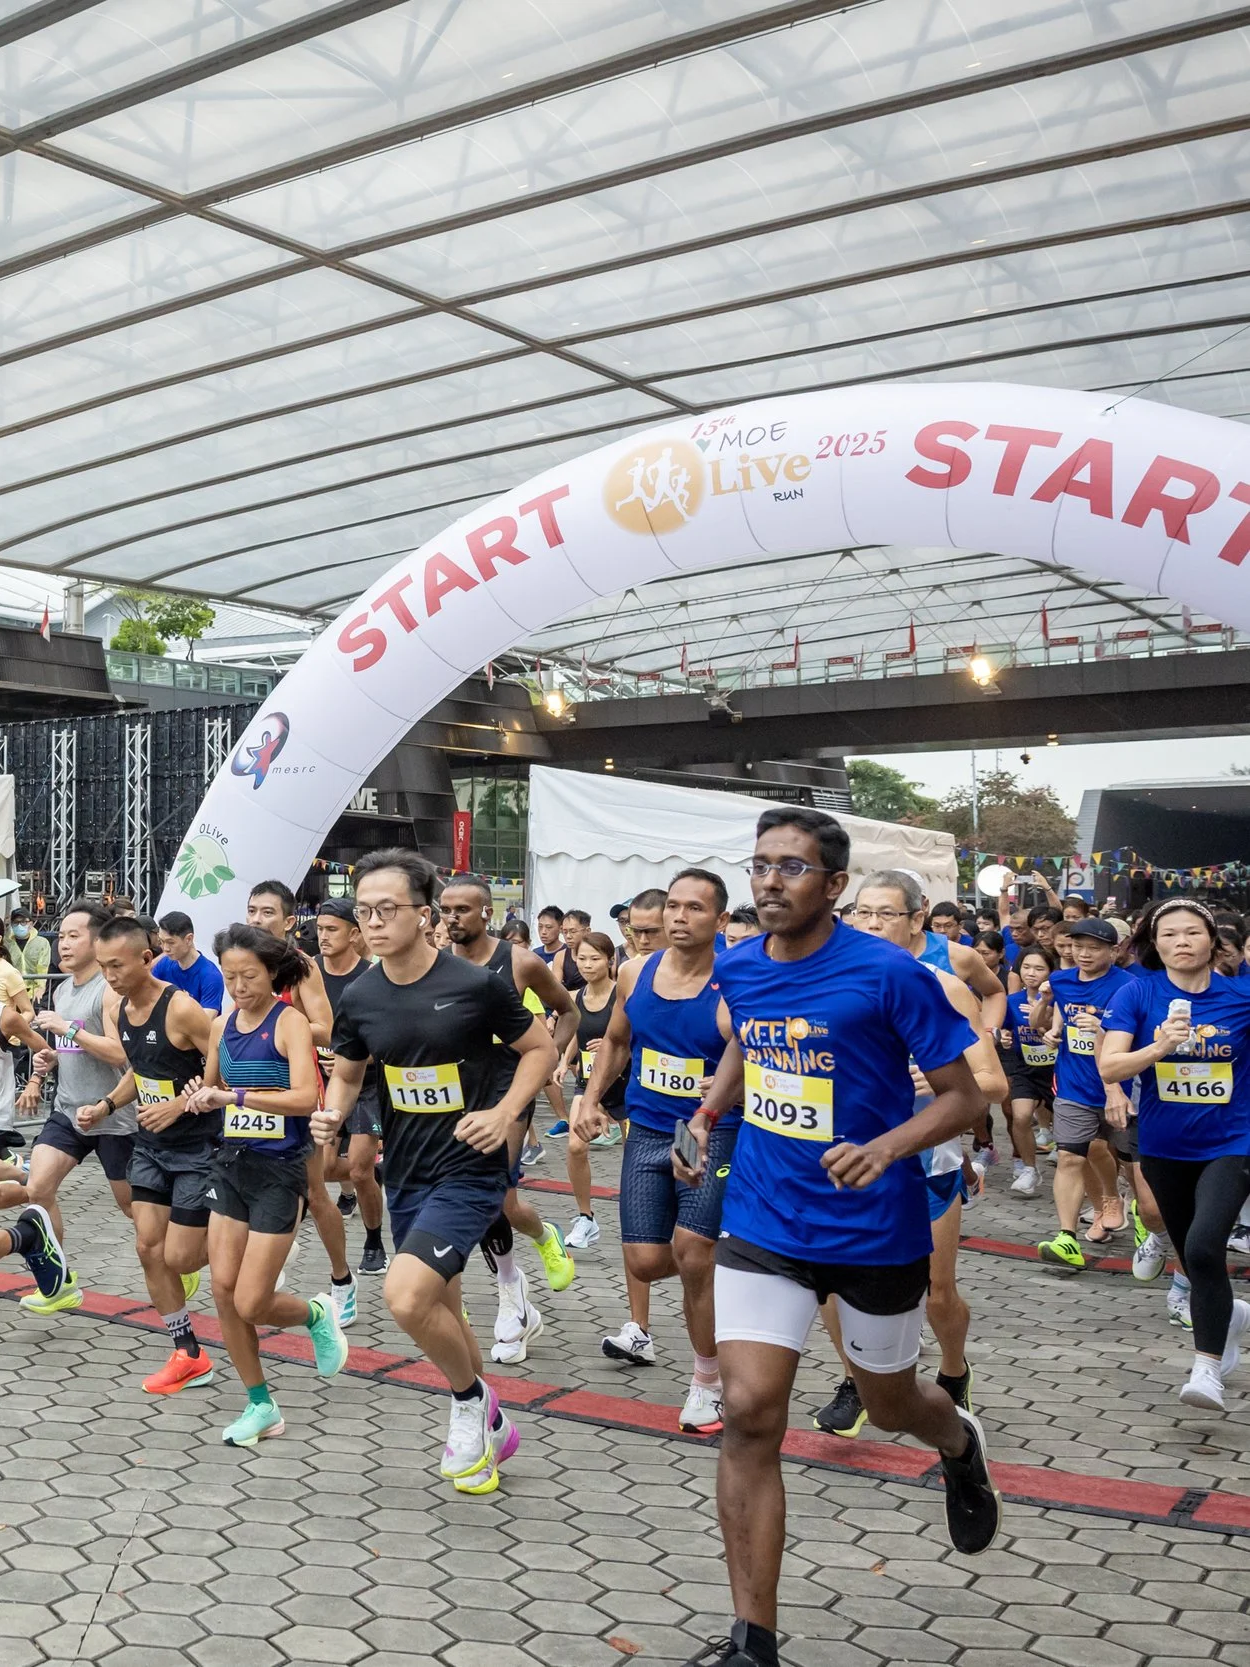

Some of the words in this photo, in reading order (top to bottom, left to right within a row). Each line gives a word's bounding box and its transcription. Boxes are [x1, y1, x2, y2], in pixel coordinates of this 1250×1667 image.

[690, 415, 736, 439] 15th
[719, 421, 788, 451] MOE
[815, 430, 888, 459] 2025
[773, 488, 804, 502] RUN
[337, 484, 570, 672] START
[272, 765, 316, 774] mesrc
[57, 1035, 79, 1048] 701
[1027, 1053, 1056, 1063] 4095
[649, 1069, 695, 1091] 1180
[1166, 1081, 1225, 1097] 4166
[397, 1087, 450, 1105] 1181
[753, 1093, 818, 1129] 2093
[230, 1115, 276, 1131] 4245
